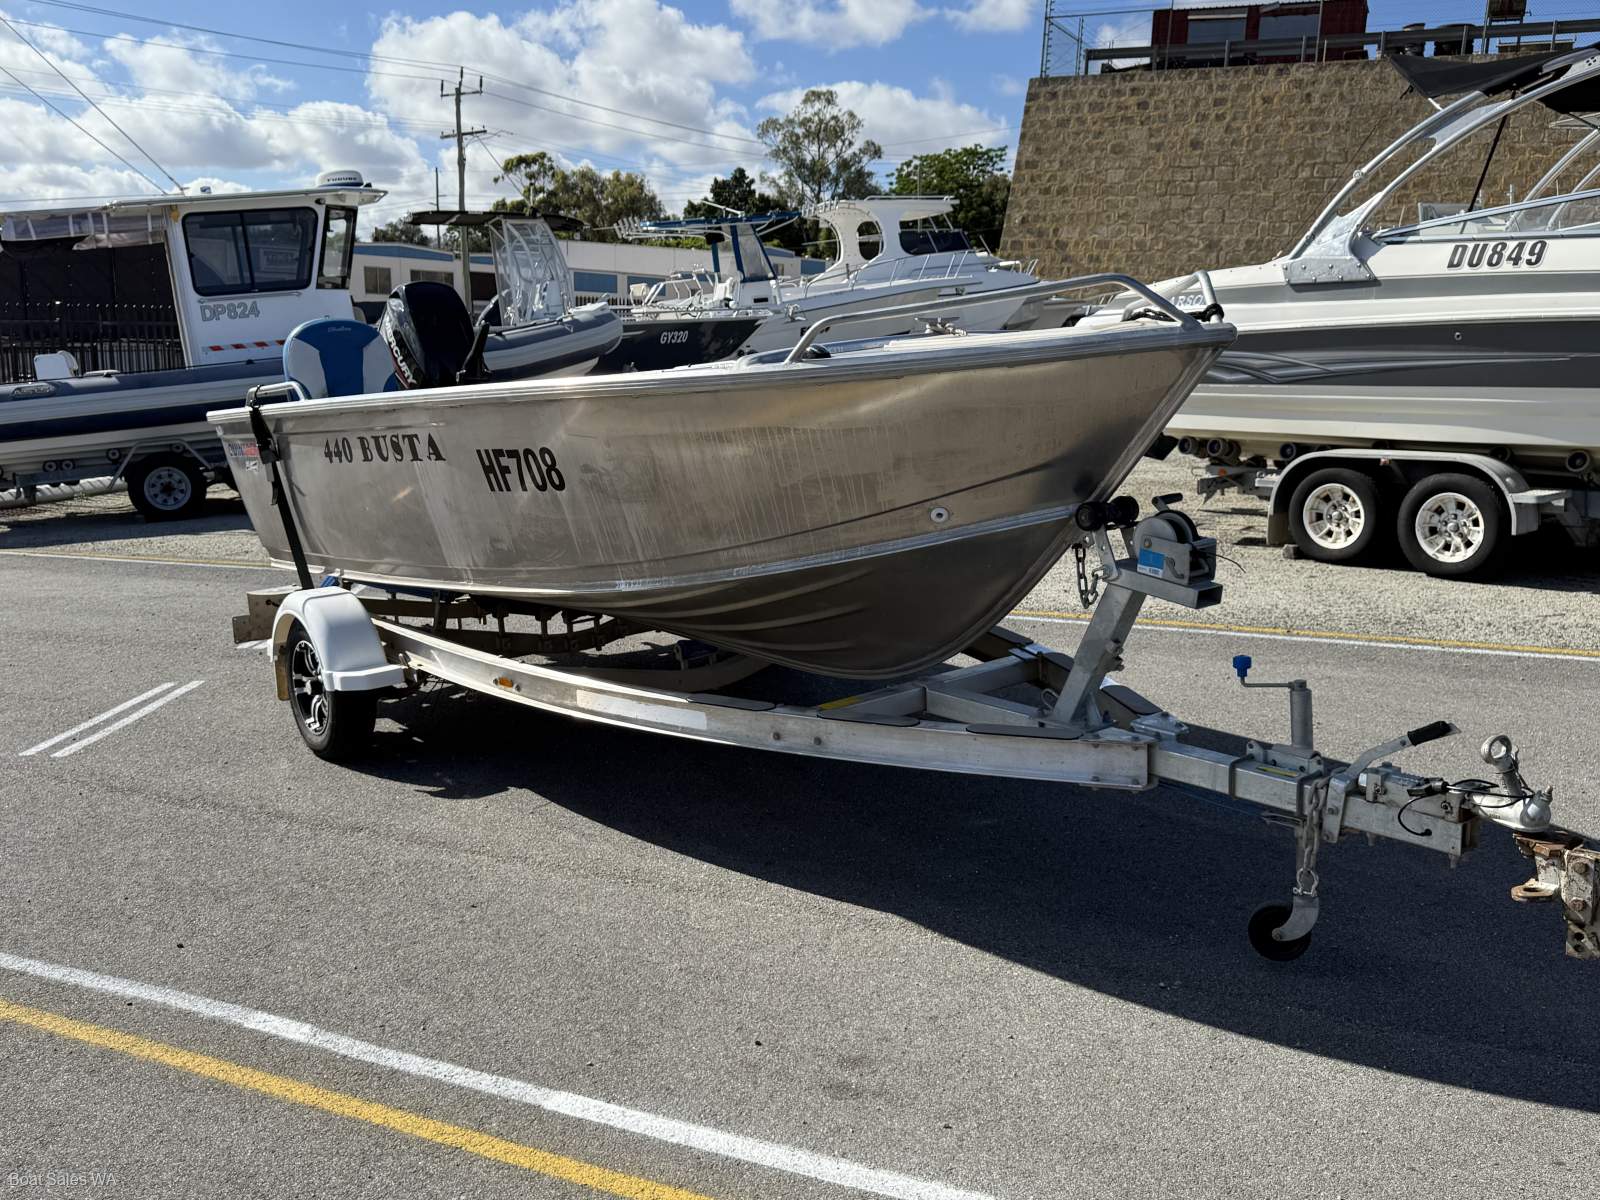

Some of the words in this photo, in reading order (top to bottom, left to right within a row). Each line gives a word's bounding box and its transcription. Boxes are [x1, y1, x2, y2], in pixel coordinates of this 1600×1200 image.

[1447, 239, 1548, 269] DU849
[200, 301, 260, 321] DP824
[660, 330, 689, 345] GY320
[324, 437, 353, 464] 440
[357, 432, 447, 462] BUSTA
[475, 446, 566, 492] HF708
